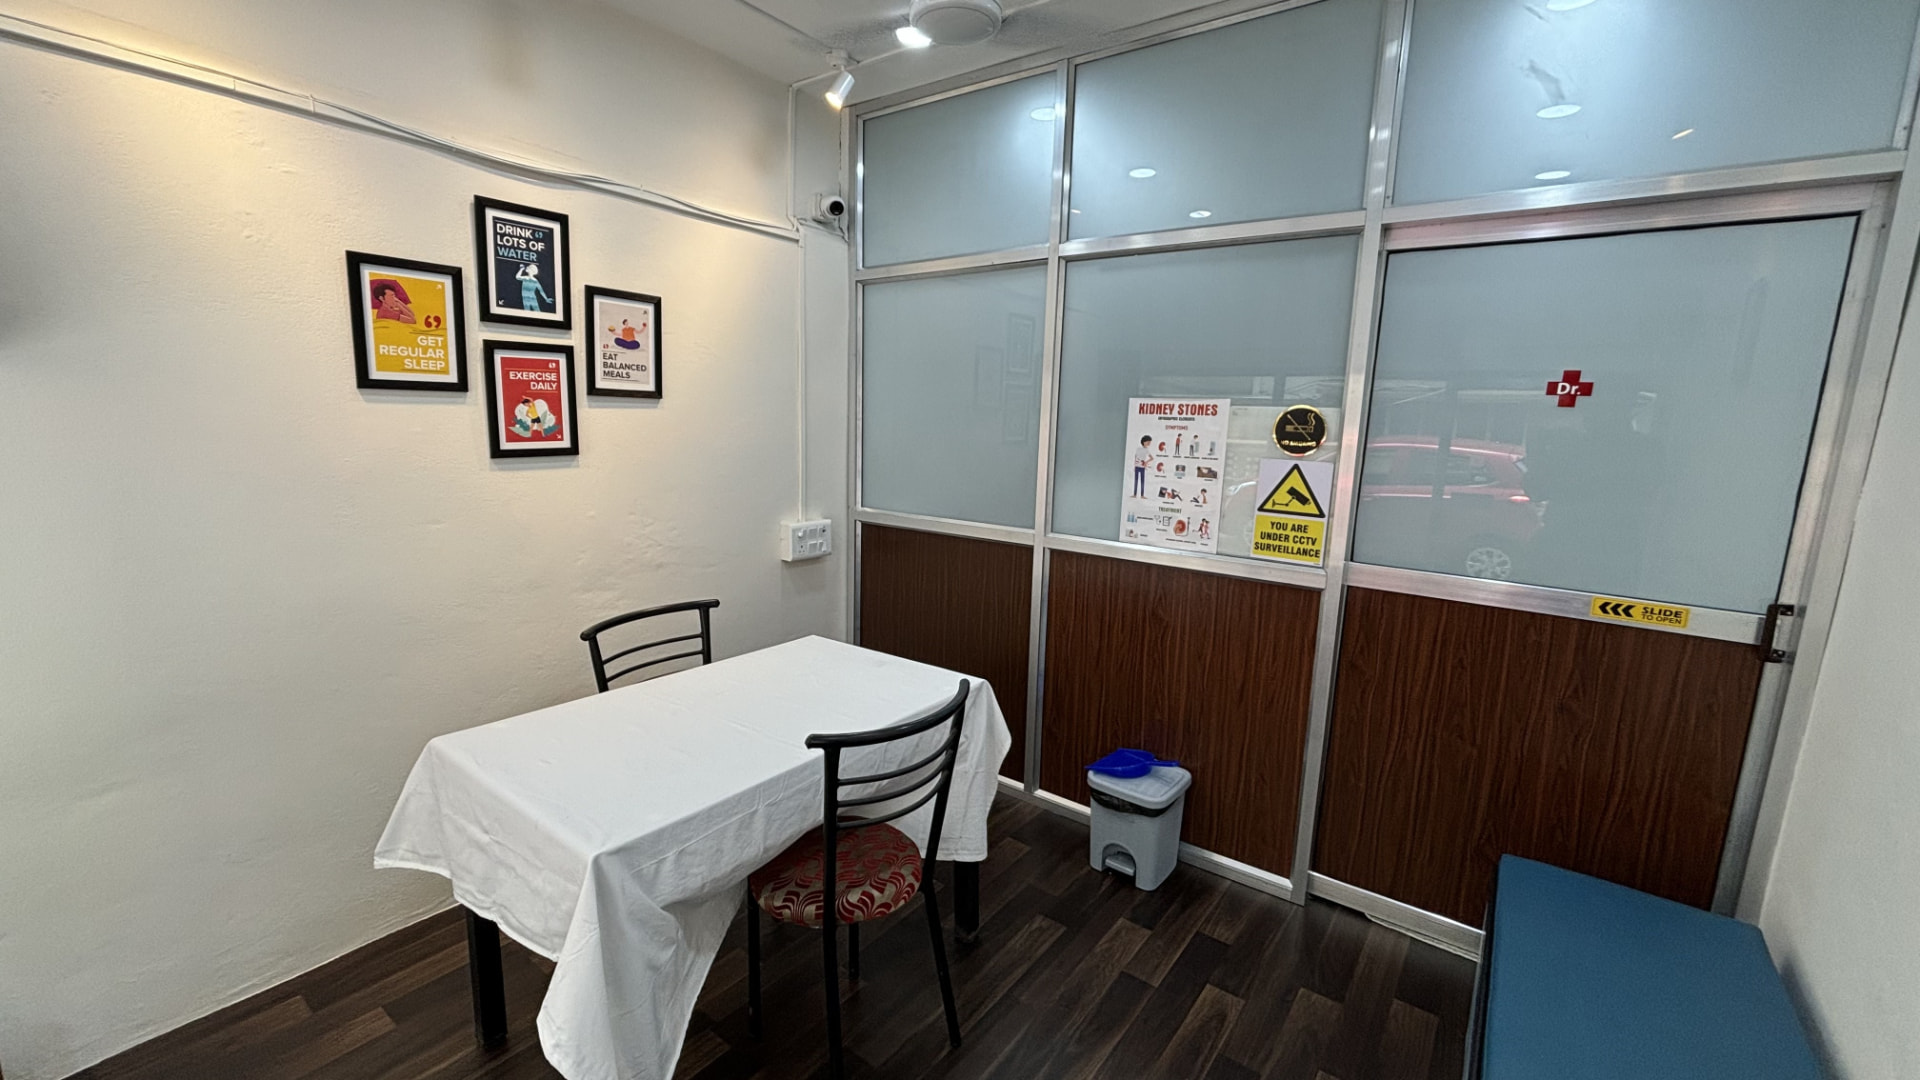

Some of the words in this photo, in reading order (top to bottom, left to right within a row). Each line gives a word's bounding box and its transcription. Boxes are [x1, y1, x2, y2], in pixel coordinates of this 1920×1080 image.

[497, 223, 533, 239] DRINK
[496, 235, 526, 249] LOTS
[529, 241, 545, 252] OF
[497, 246, 537, 261] WATER
[417, 335, 444, 347] GET
[379, 344, 445, 359] REGULAR
[602, 352, 618, 361] EAT
[404, 358, 446, 371] SLEEP
[602, 361, 648, 372] BALANCED
[509, 371, 558, 381] EXERCISE
[602, 370, 631, 379] MEALS
[530, 381, 558, 391] DAILY
[1557, 382, 1581, 395] Dr.
[1138, 403, 1175, 415] KIDNEY
[1177, 403, 1218, 417] STONES
[1270, 521, 1288, 531] YOU
[1290, 524, 1309, 533] ARE
[1260, 531, 1290, 543] UNDER
[1292, 535, 1317, 546] CCTV
[1254, 541, 1321, 558] SURVEILLANCE
[1641, 606, 1684, 618] SLIDE
[1641, 613, 1654, 621] TO
[1655, 615, 1682, 625] OPEN
